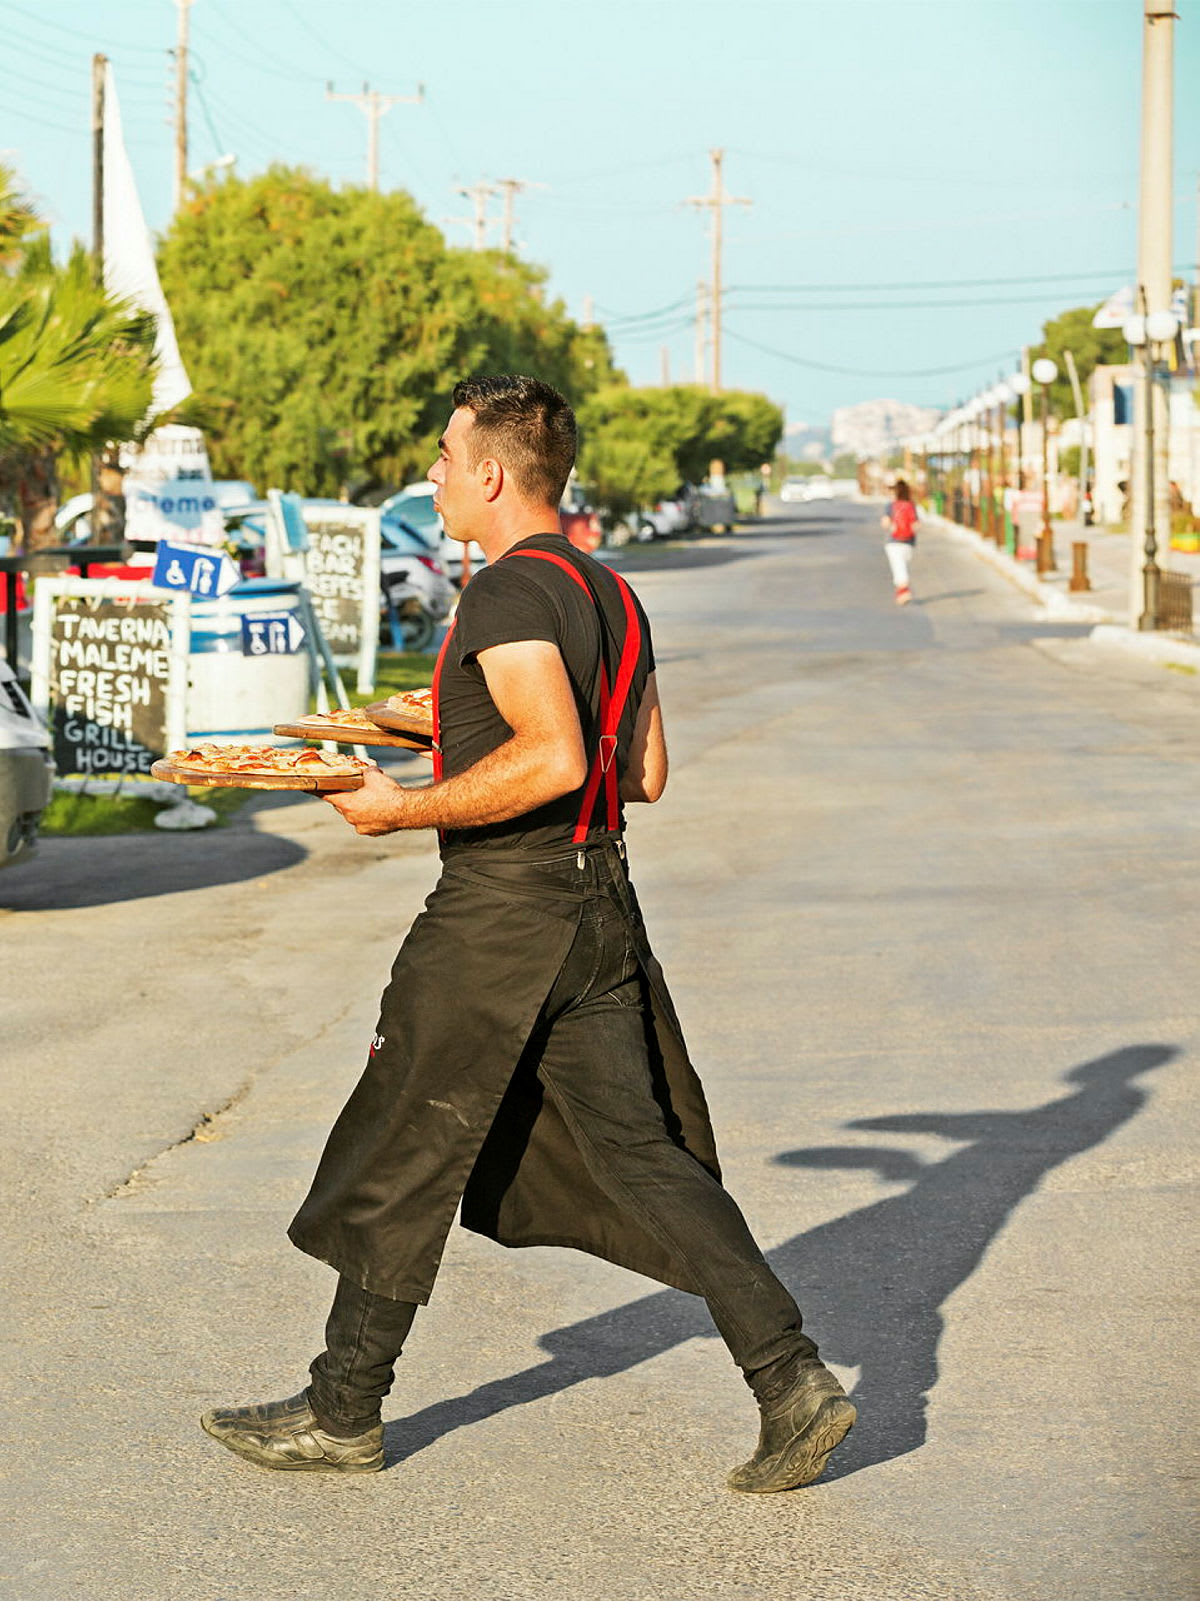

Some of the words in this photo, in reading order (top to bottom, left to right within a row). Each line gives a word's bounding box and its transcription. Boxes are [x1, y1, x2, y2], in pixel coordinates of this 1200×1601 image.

[57, 614, 170, 651] TAVERNA
[60, 640, 170, 679] MALEME
[60, 670, 150, 706] FRESH
[66, 694, 133, 729] FISH
[64, 719, 145, 751] GRILL
[76, 748, 152, 772] HOUSE
